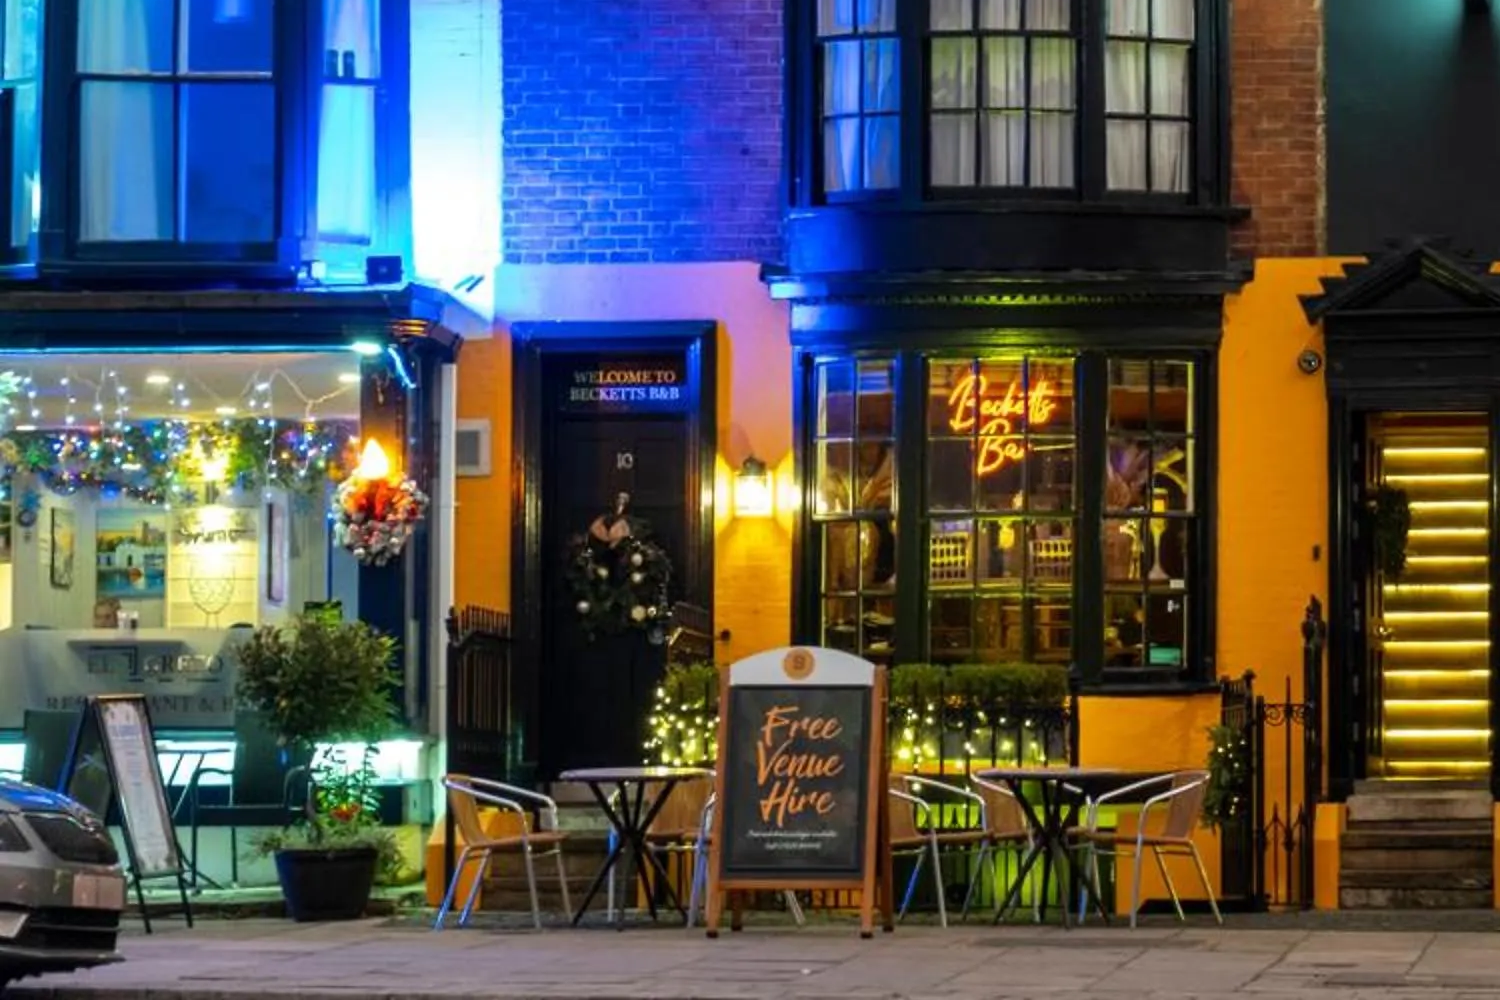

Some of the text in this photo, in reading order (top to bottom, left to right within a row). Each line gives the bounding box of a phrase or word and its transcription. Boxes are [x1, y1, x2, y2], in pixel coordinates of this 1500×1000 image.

[573, 370, 676, 384] WELCOME TO
[570, 387, 680, 401] BECKETTS B&B
[617, 453, 633, 469] 10
[761, 705, 842, 747] Free
[756, 739, 845, 786] Venue
[760, 780, 836, 828] Hire
